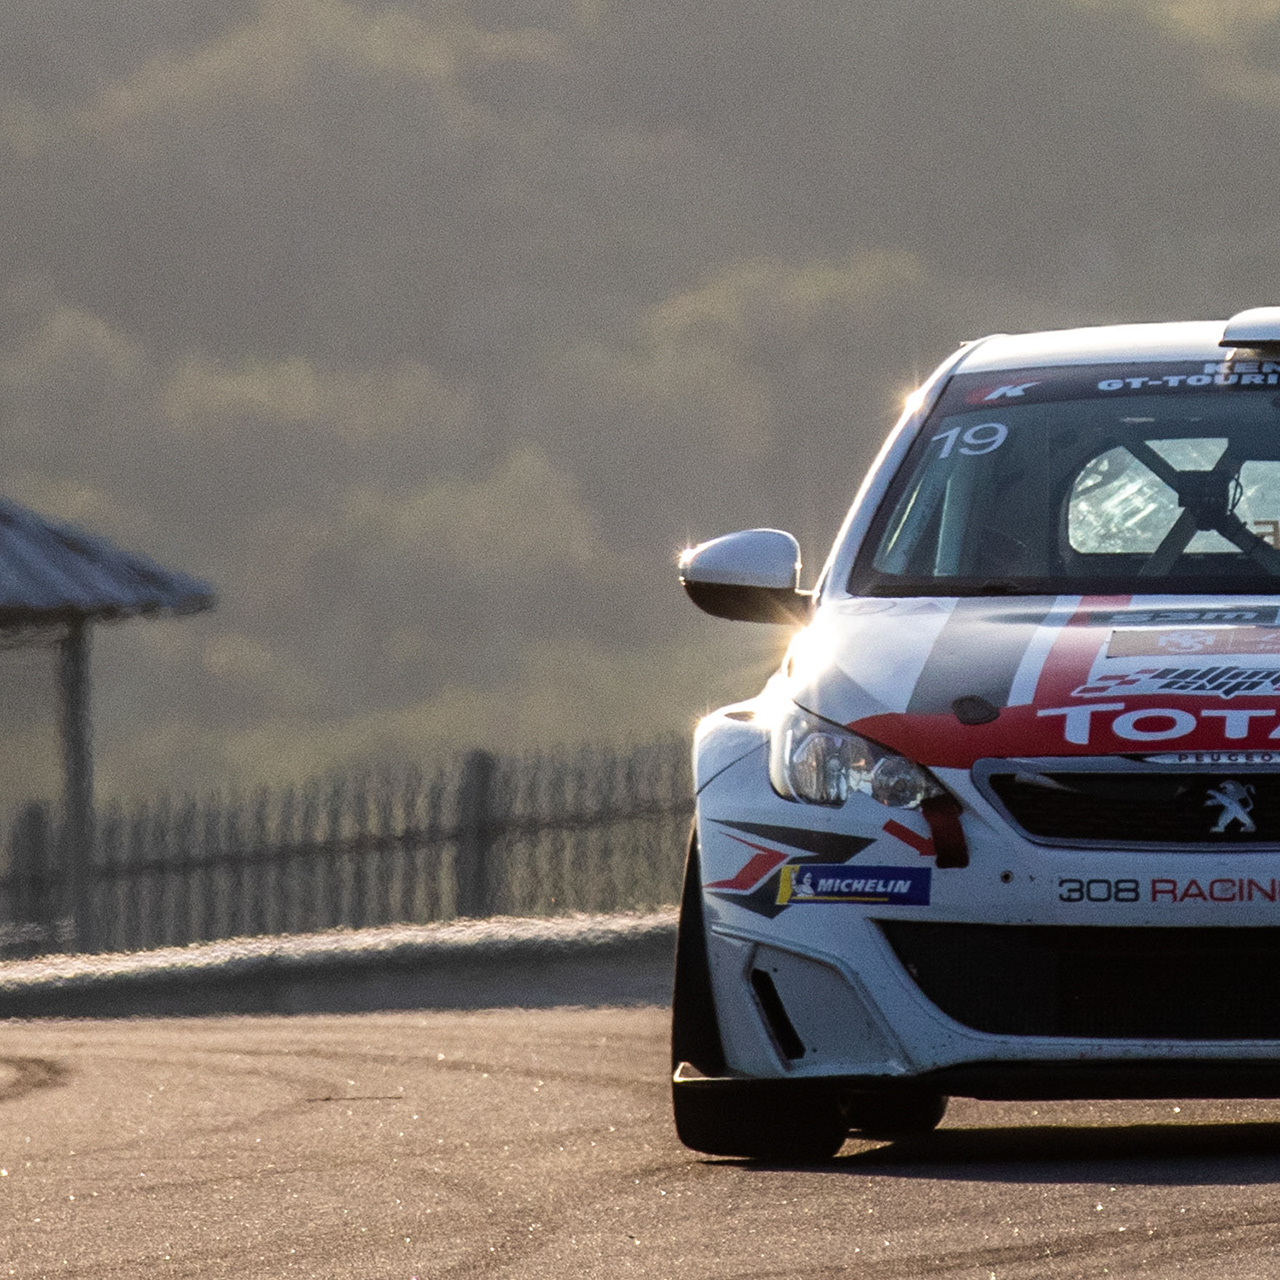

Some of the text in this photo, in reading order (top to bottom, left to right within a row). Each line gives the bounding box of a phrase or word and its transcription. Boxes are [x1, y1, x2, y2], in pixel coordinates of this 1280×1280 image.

[931, 423, 1009, 459] 19
[817, 878, 912, 894] MICHELIN
[1058, 878, 1140, 902] 308
